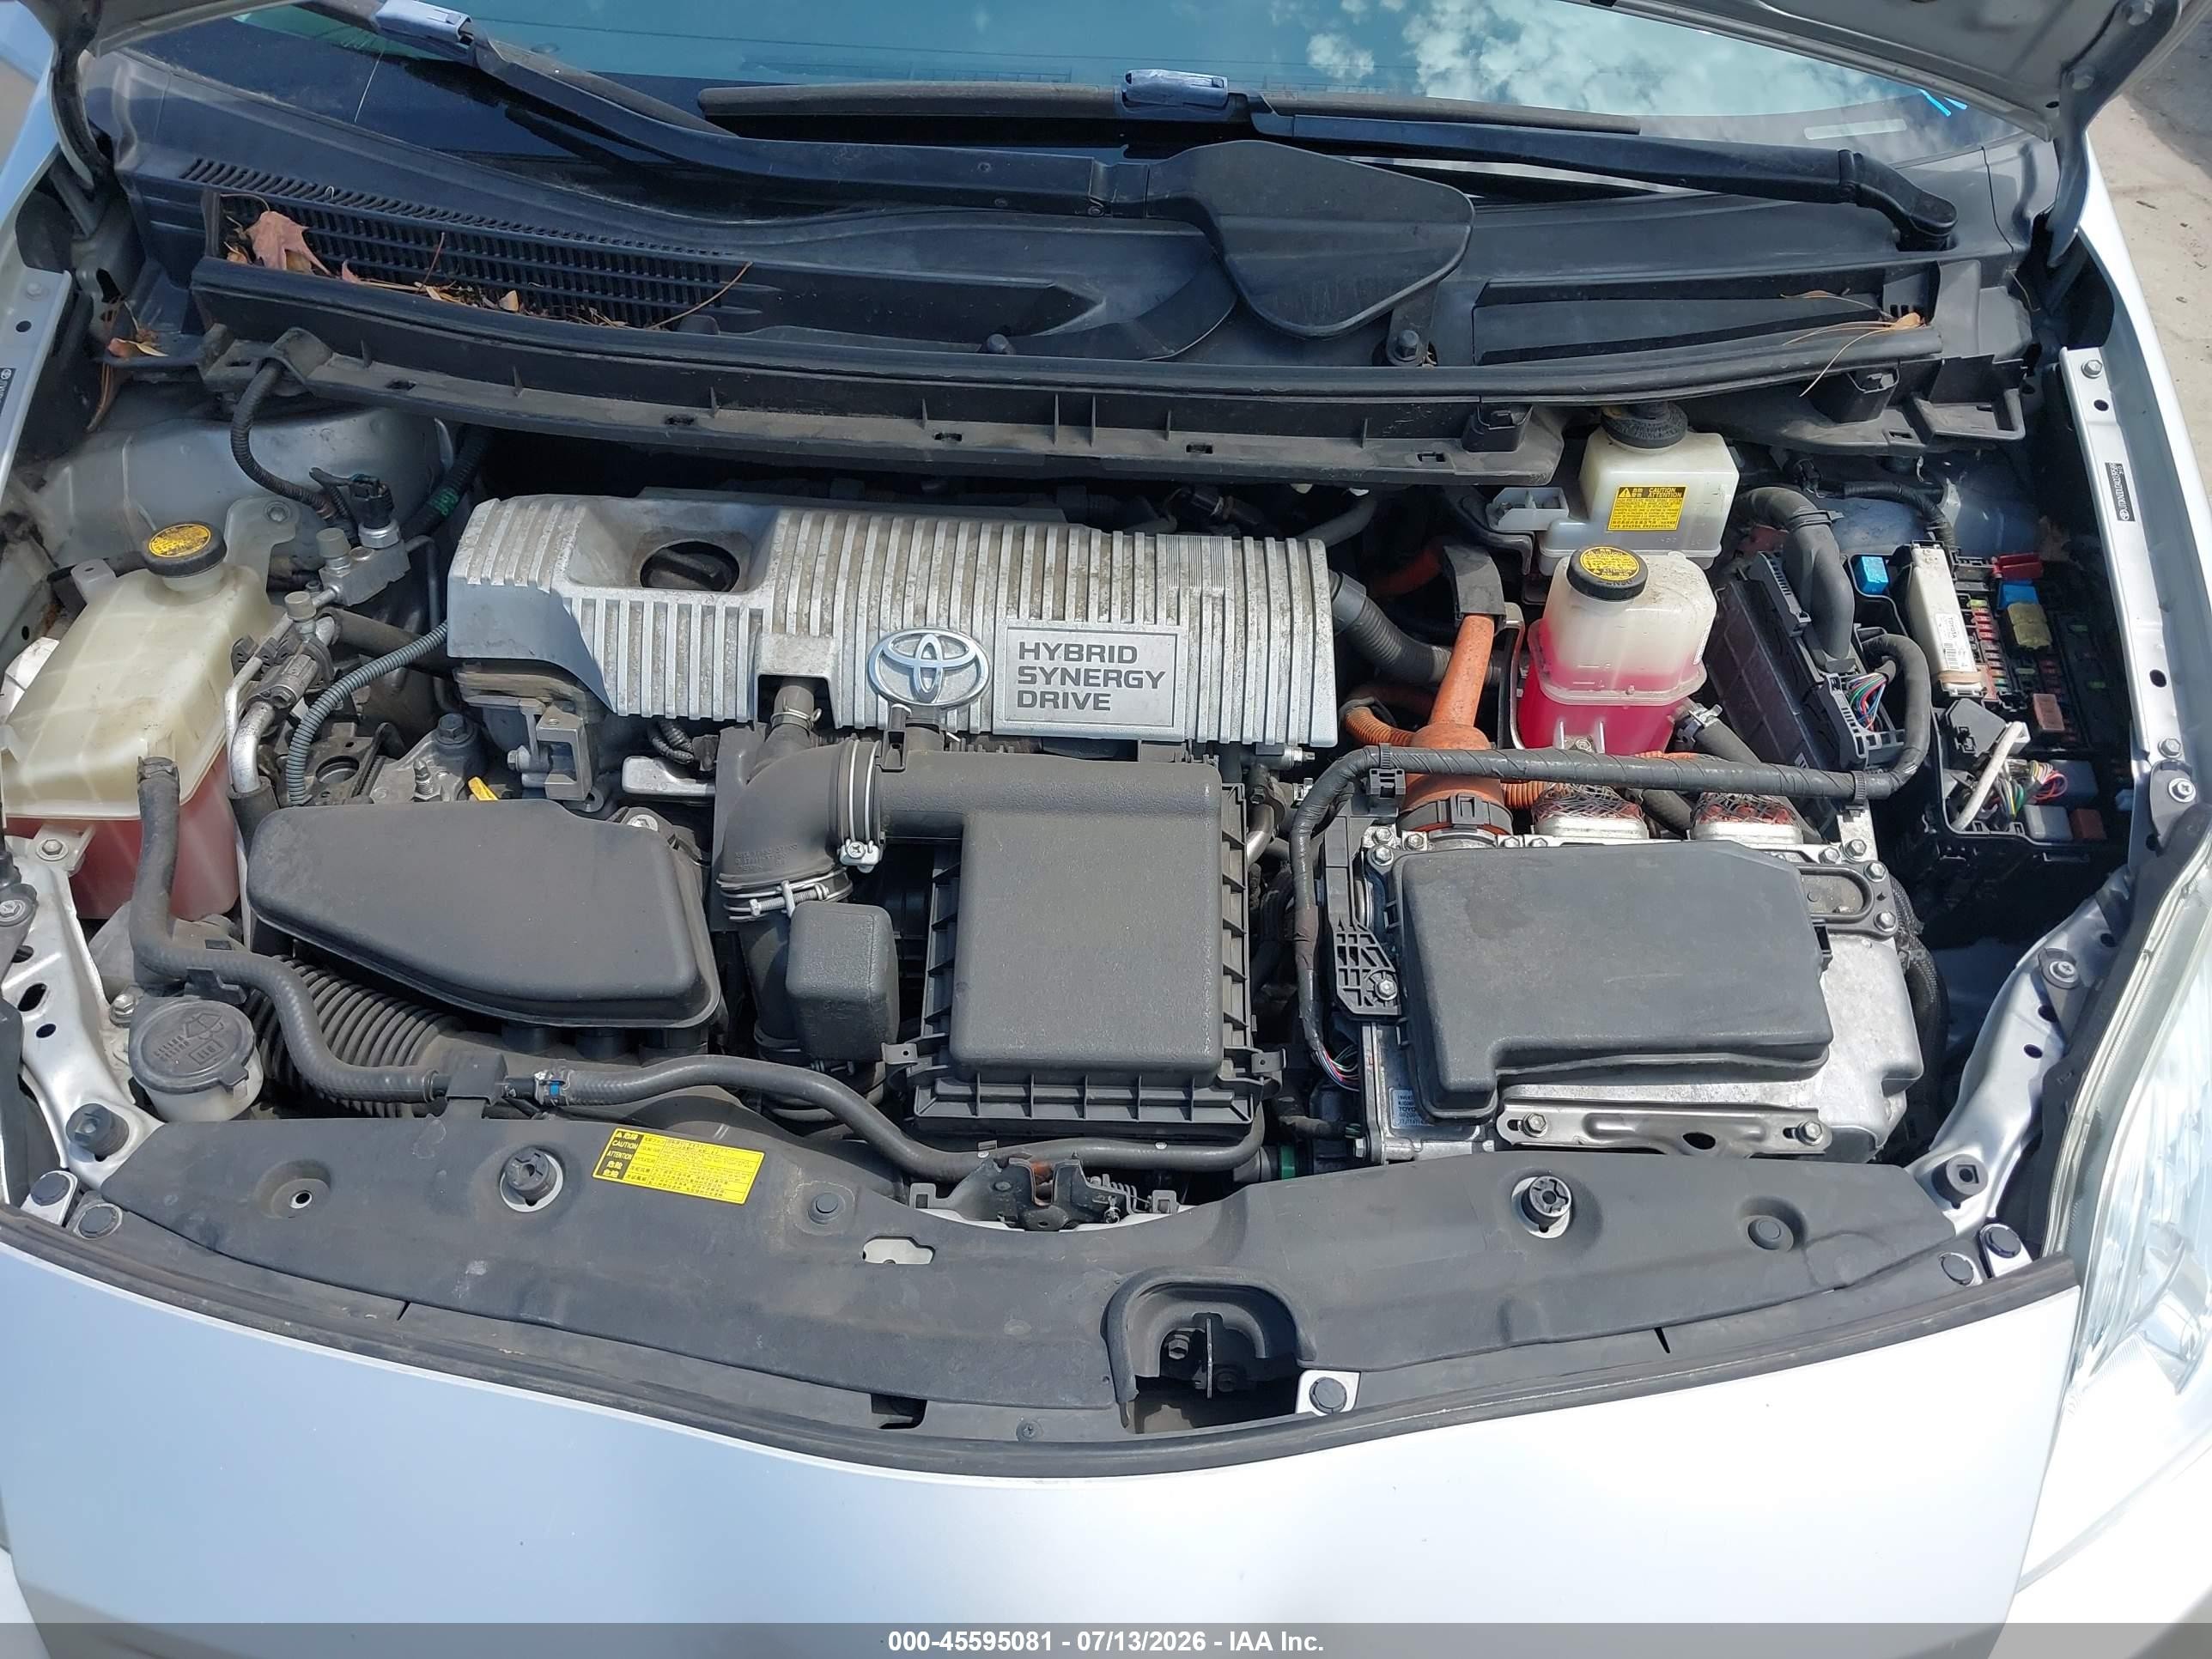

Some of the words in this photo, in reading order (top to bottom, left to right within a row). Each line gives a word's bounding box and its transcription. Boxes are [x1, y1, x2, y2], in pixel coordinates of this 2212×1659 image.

[1948, 617, 1958, 639] TOYOTA
[1018, 641, 1138, 664] HYBRID
[1018, 665, 1166, 689] SYNERGY
[1017, 690, 1111, 711] DRIVE
[611, 1139, 638, 1149] CAUTION
[607, 1151, 633, 1160] ATTENTION
